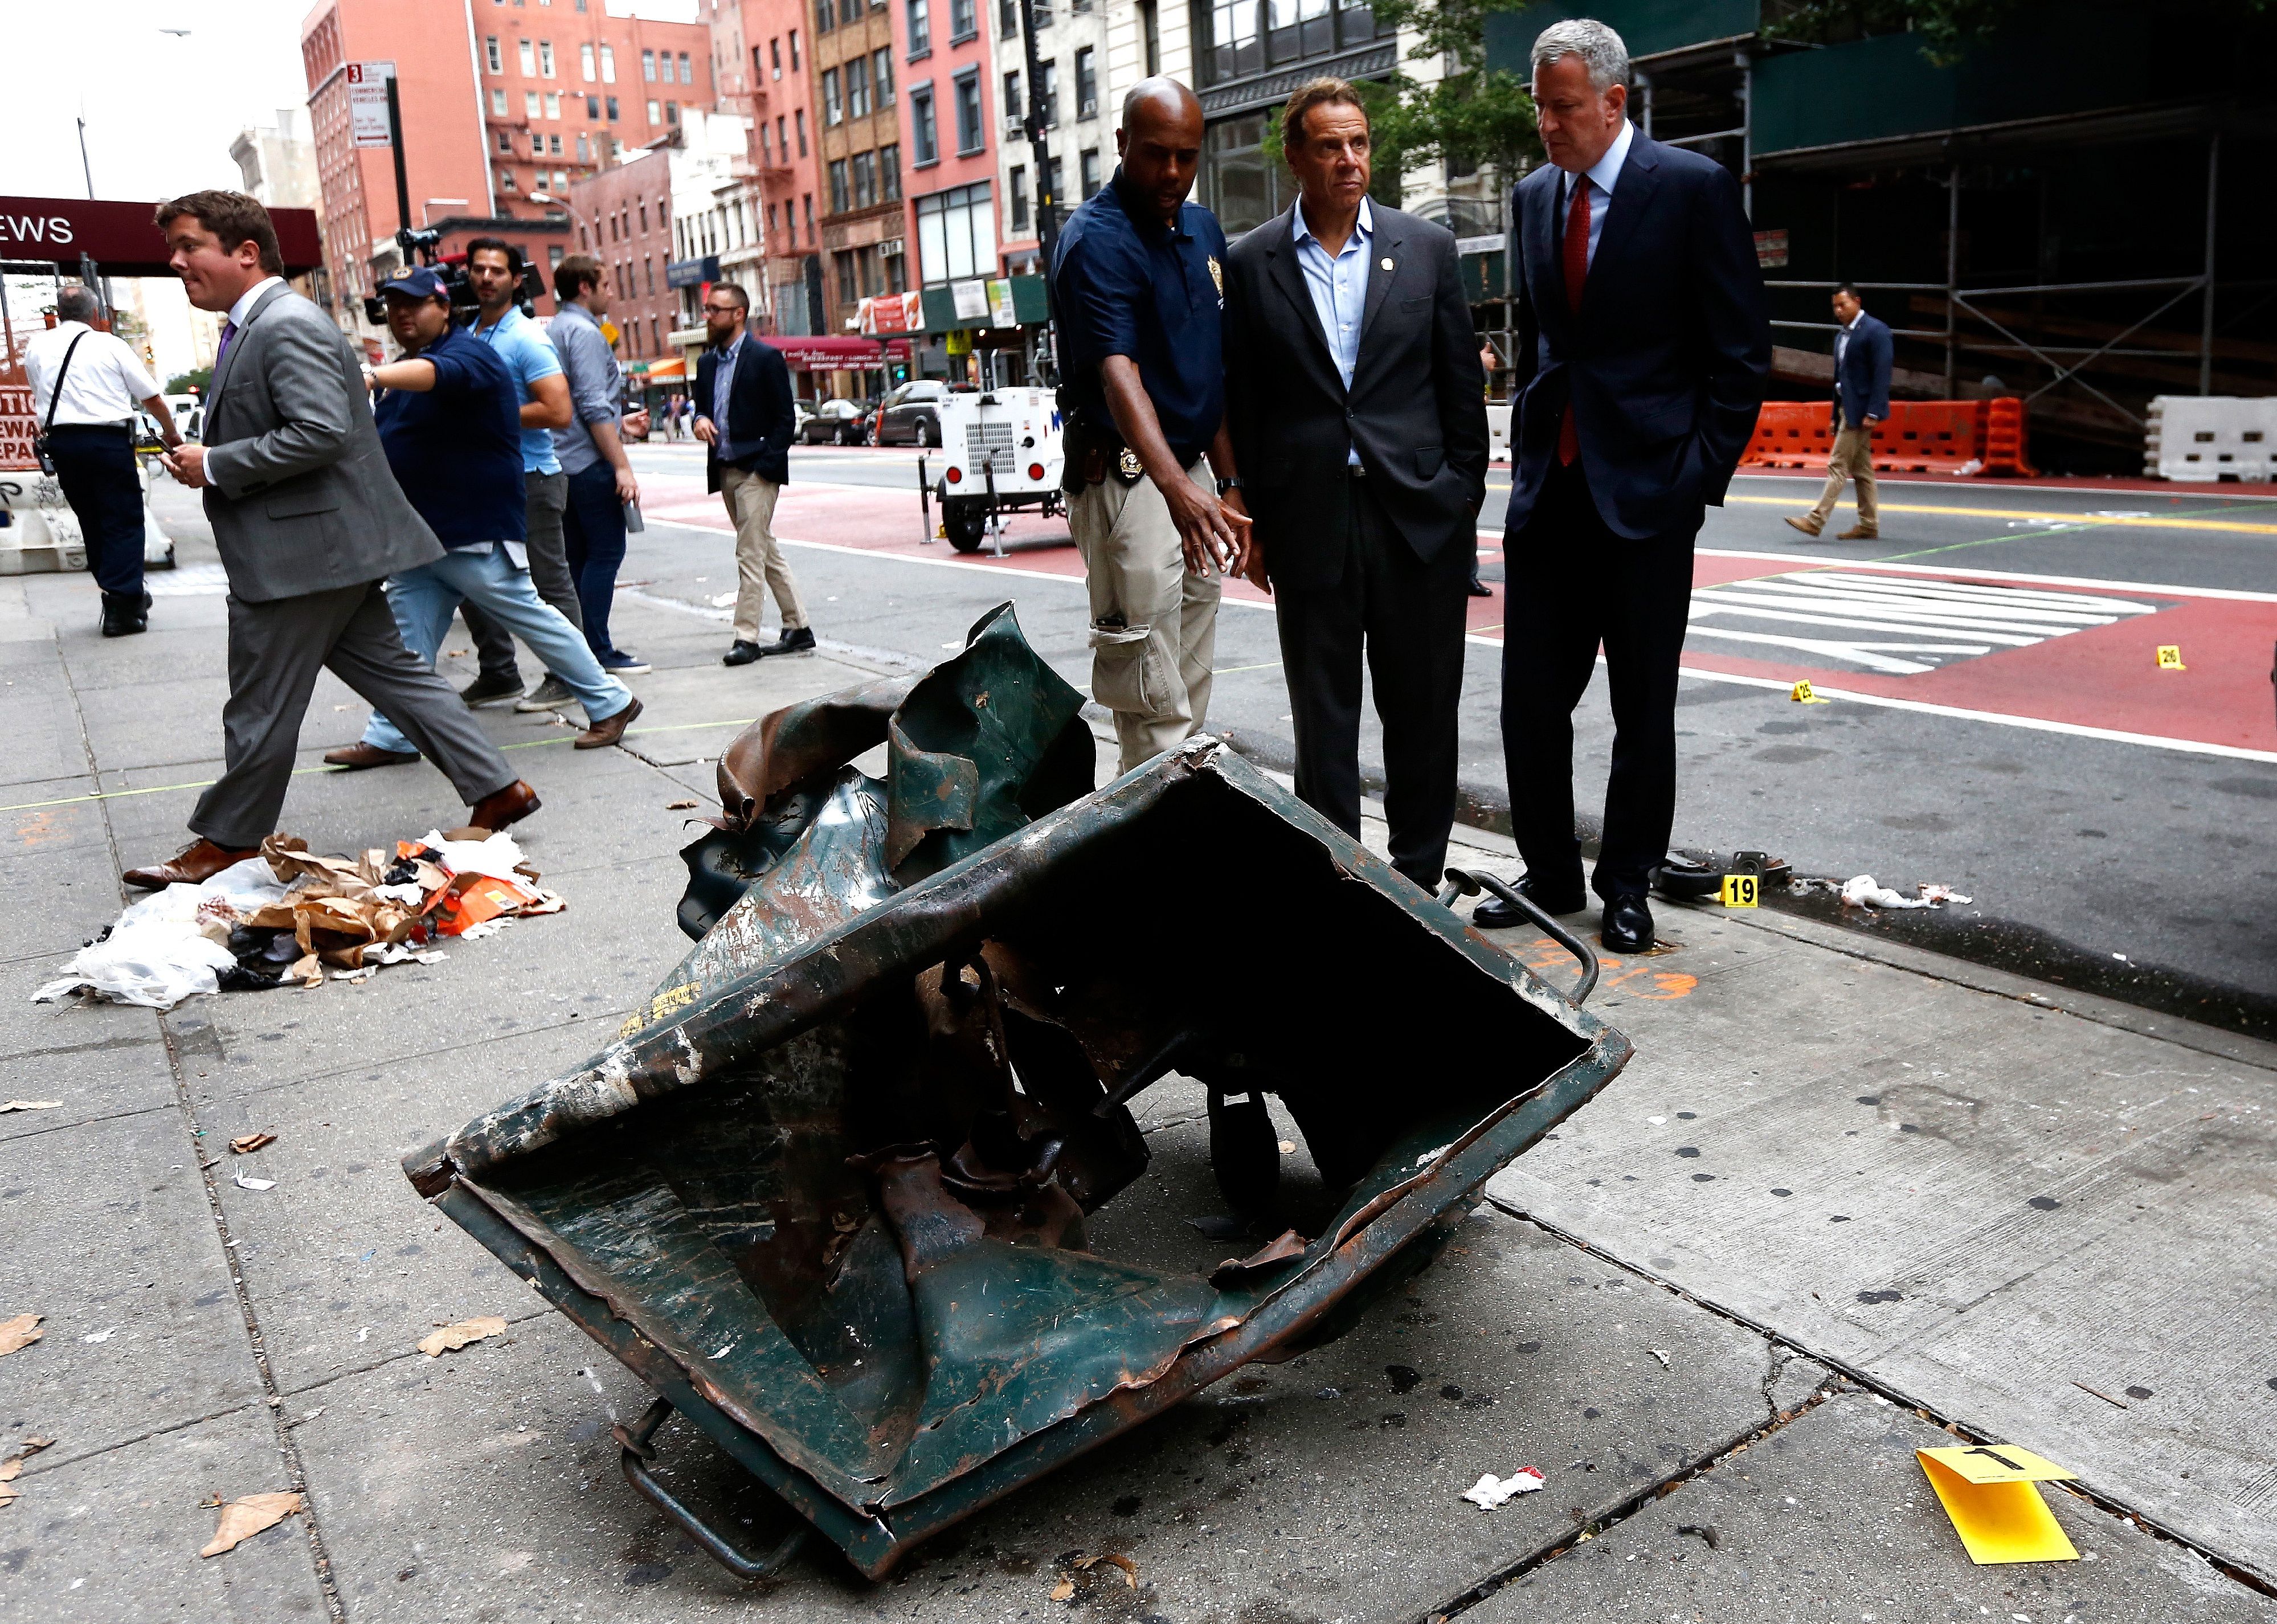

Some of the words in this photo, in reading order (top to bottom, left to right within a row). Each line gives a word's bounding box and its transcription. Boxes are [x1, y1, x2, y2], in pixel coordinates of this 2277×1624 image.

[350, 65, 359, 83] 3
[1800, 684, 1812, 698] 25
[1730, 878, 1755, 903] 19
[1962, 1447, 2026, 1470] 1
